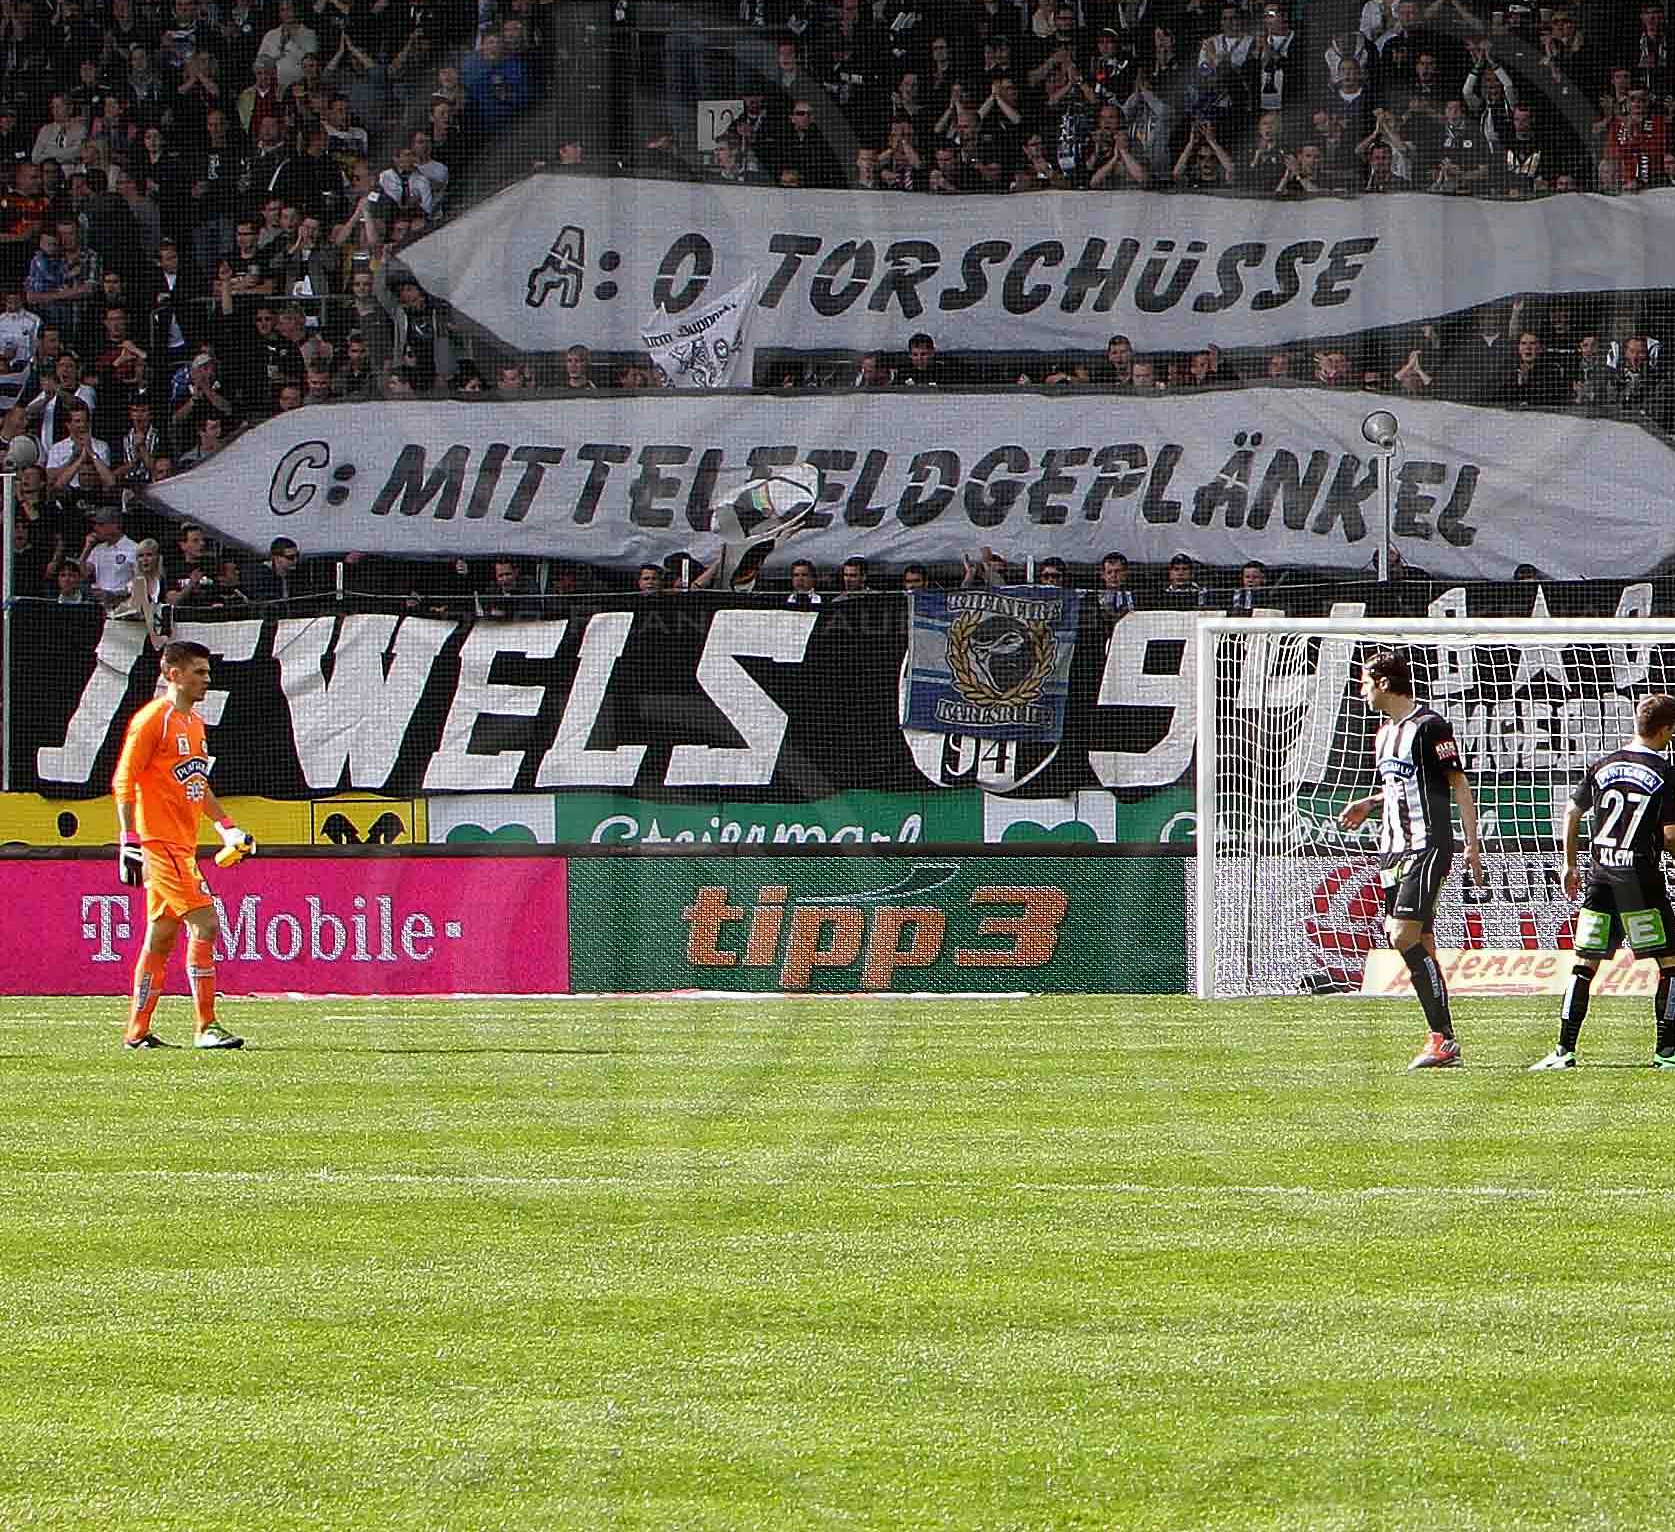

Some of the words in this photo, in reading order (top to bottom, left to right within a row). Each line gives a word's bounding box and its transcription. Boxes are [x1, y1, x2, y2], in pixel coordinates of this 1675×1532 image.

[758, 232, 1379, 319] TORSCHÜSSE
[268, 439, 356, 516] C:
[1593, 788, 1652, 850] 27
[1599, 848, 1635, 868] KLEM
[683, 884, 1069, 990] tipp3
